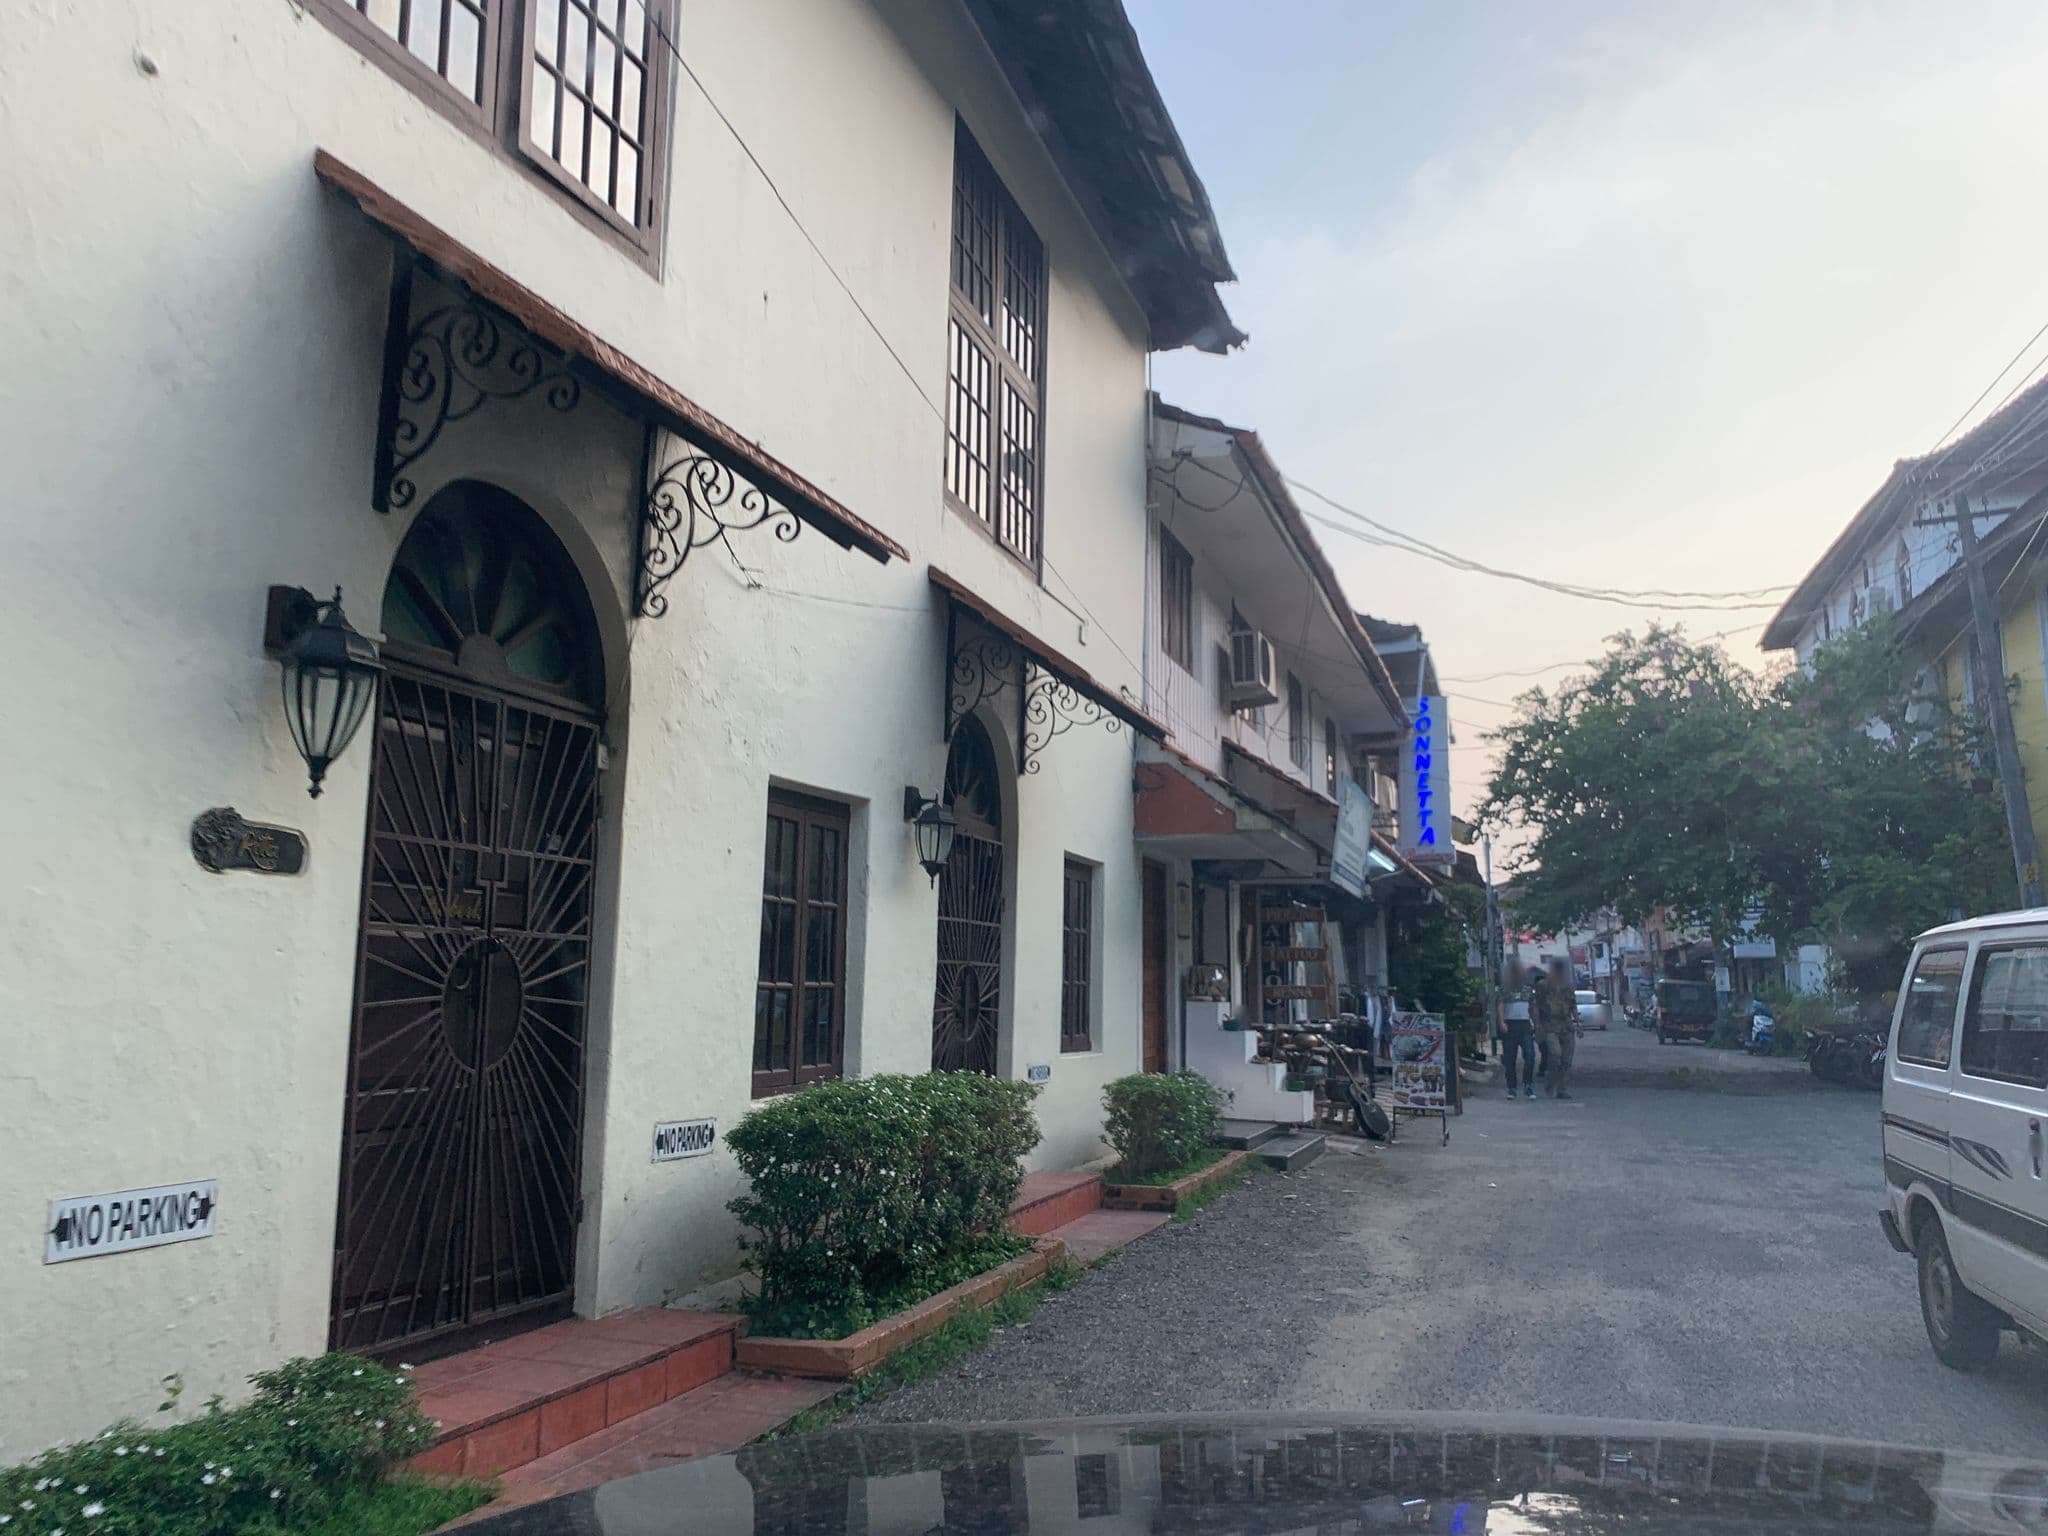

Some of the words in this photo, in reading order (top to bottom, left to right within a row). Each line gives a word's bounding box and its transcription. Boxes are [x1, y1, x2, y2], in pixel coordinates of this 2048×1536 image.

[1414, 695, 1435, 846] SONNETTA
[663, 1128, 676, 1154] NO
[677, 1123, 709, 1152] PARKING
[68, 1204, 104, 1249] NO
[106, 1190, 200, 1243] PARKING
